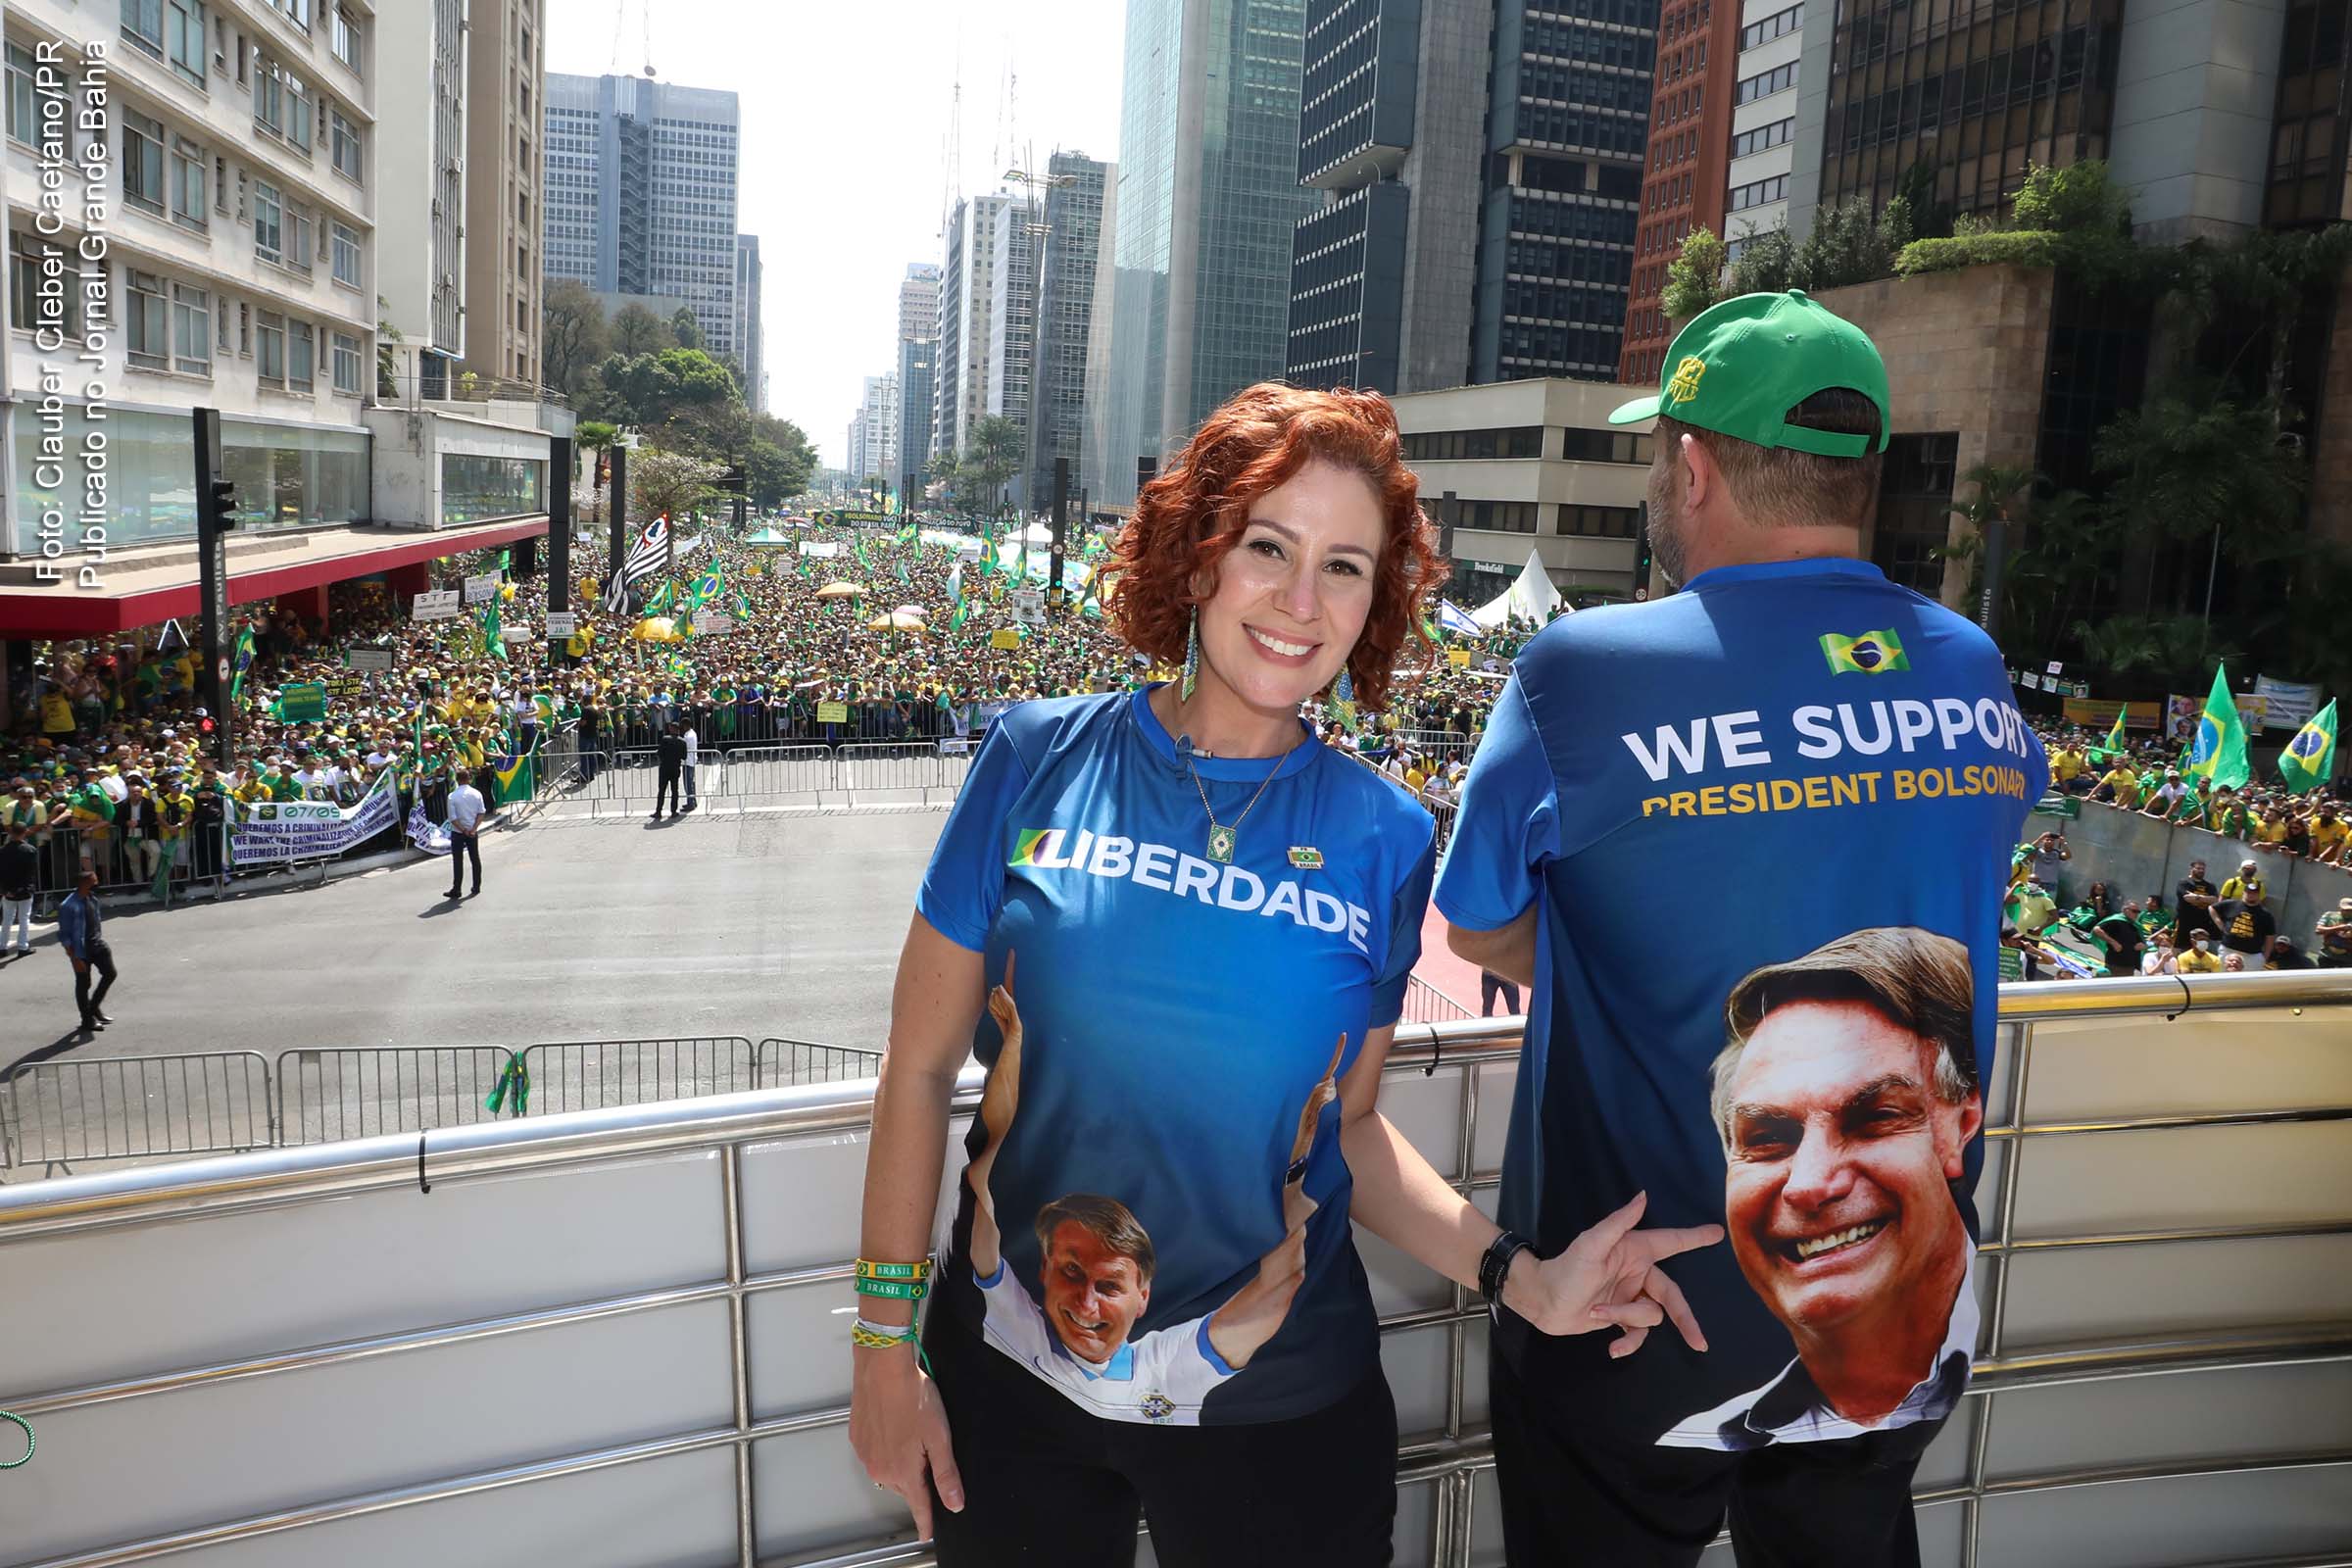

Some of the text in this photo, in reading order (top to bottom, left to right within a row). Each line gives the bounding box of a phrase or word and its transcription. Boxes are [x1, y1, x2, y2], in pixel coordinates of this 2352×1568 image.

[1982, 588, 1991, 628] aulista
[1621, 698, 2028, 782] WE SUPPORT
[1642, 765, 2026, 816] PRESIDENT BOLSONAR
[1042, 829, 1370, 954] LIBERDADE
[867, 1283, 901, 1295] BRASIL
[877, 1266, 911, 1275] BRASIL
